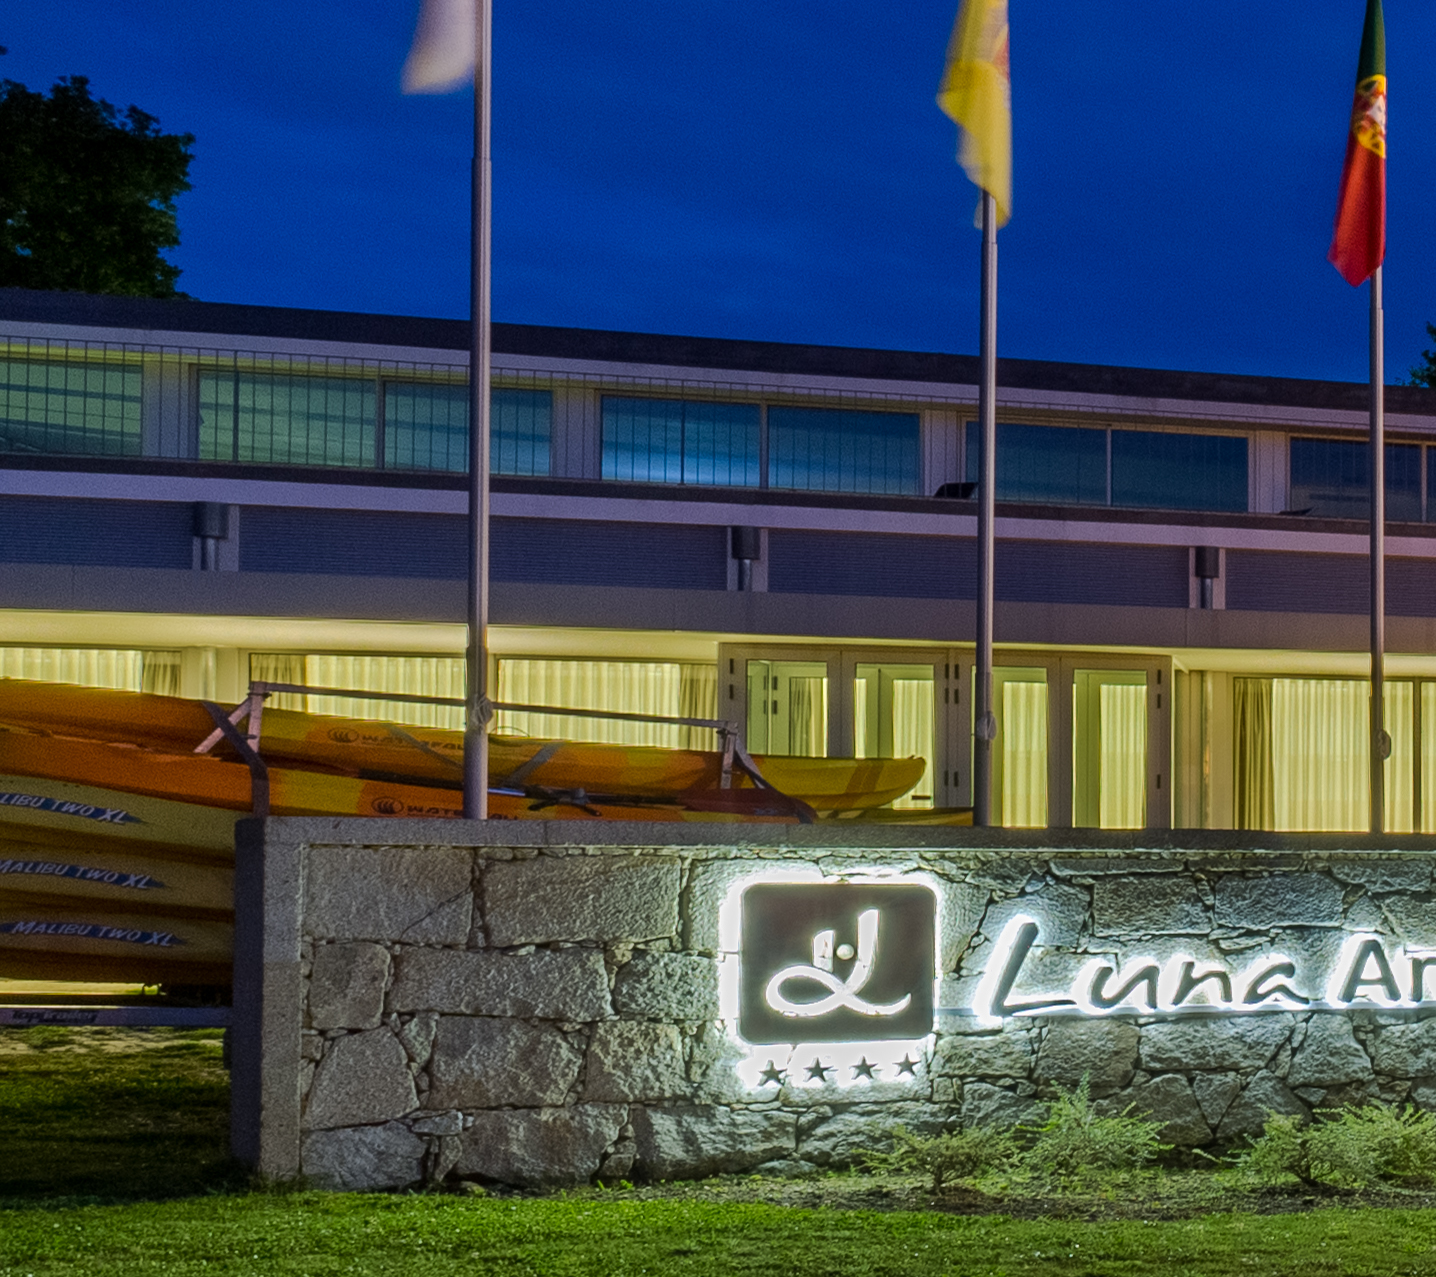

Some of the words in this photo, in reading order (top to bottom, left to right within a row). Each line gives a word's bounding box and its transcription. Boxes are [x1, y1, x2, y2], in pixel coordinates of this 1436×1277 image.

[52, 799, 95, 816] TWO
[98, 808, 127, 823] XL
[0, 859, 70, 875] MALIBU
[75, 866, 119, 882] TWO
[122, 873, 151, 889] XL
[11, 920, 93, 935] MALIBU
[98, 926, 142, 941] TWO
[144, 931, 174, 947] XL
[989, 921, 1309, 1017] Luna
